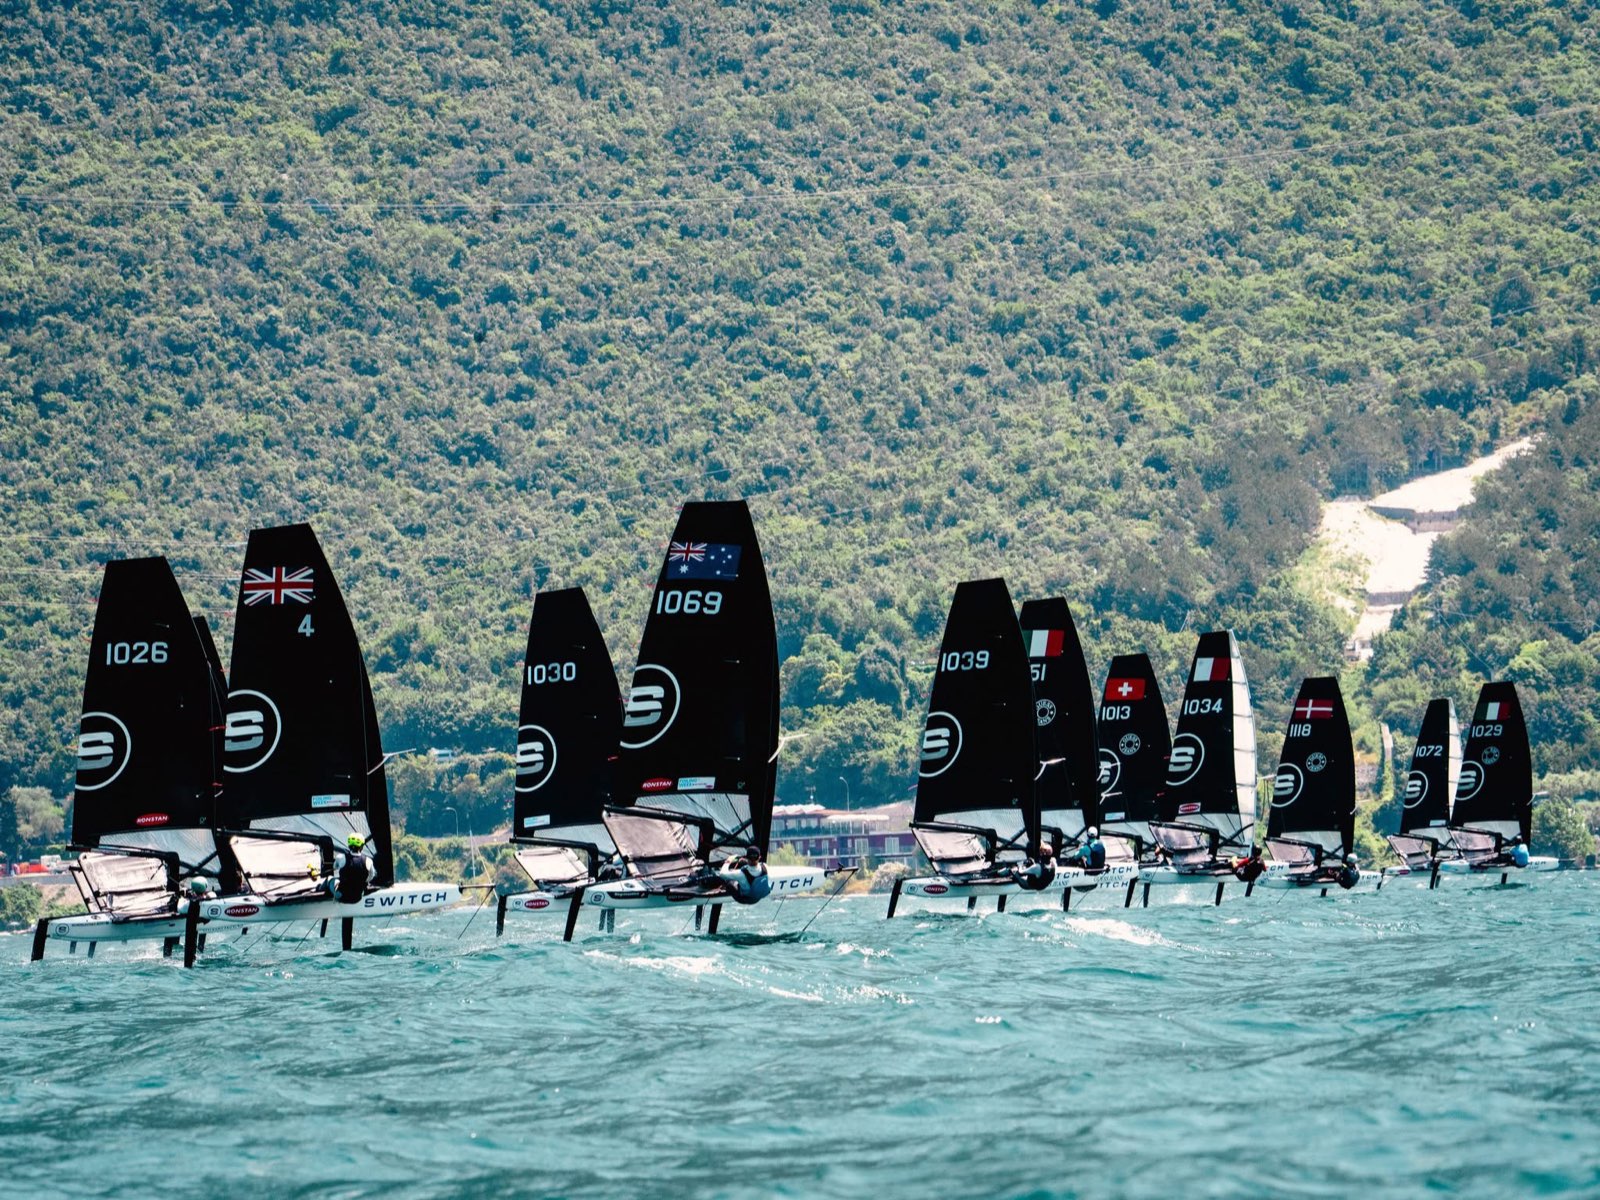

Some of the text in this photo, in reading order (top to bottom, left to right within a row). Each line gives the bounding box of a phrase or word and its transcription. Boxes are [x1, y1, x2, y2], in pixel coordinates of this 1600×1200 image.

[656, 590, 723, 615] 1069
[298, 614, 314, 637] 4
[106, 641, 169, 665] 1026
[941, 650, 990, 672] 1039
[527, 661, 577, 685] 1030
[1102, 705, 1131, 721] 1013
[1183, 698, 1223, 715] 1034
[1289, 723, 1312, 737] 1118
[1471, 724, 1503, 738] 1029
[1415, 745, 1443, 758] 1072
[641, 780, 672, 789] RONSTAN
[135, 815, 169, 825] RONSTAN
[769, 876, 814, 891] ITCH
[364, 891, 448, 908] SWITCH
[225, 905, 260, 916] RONSTAN
